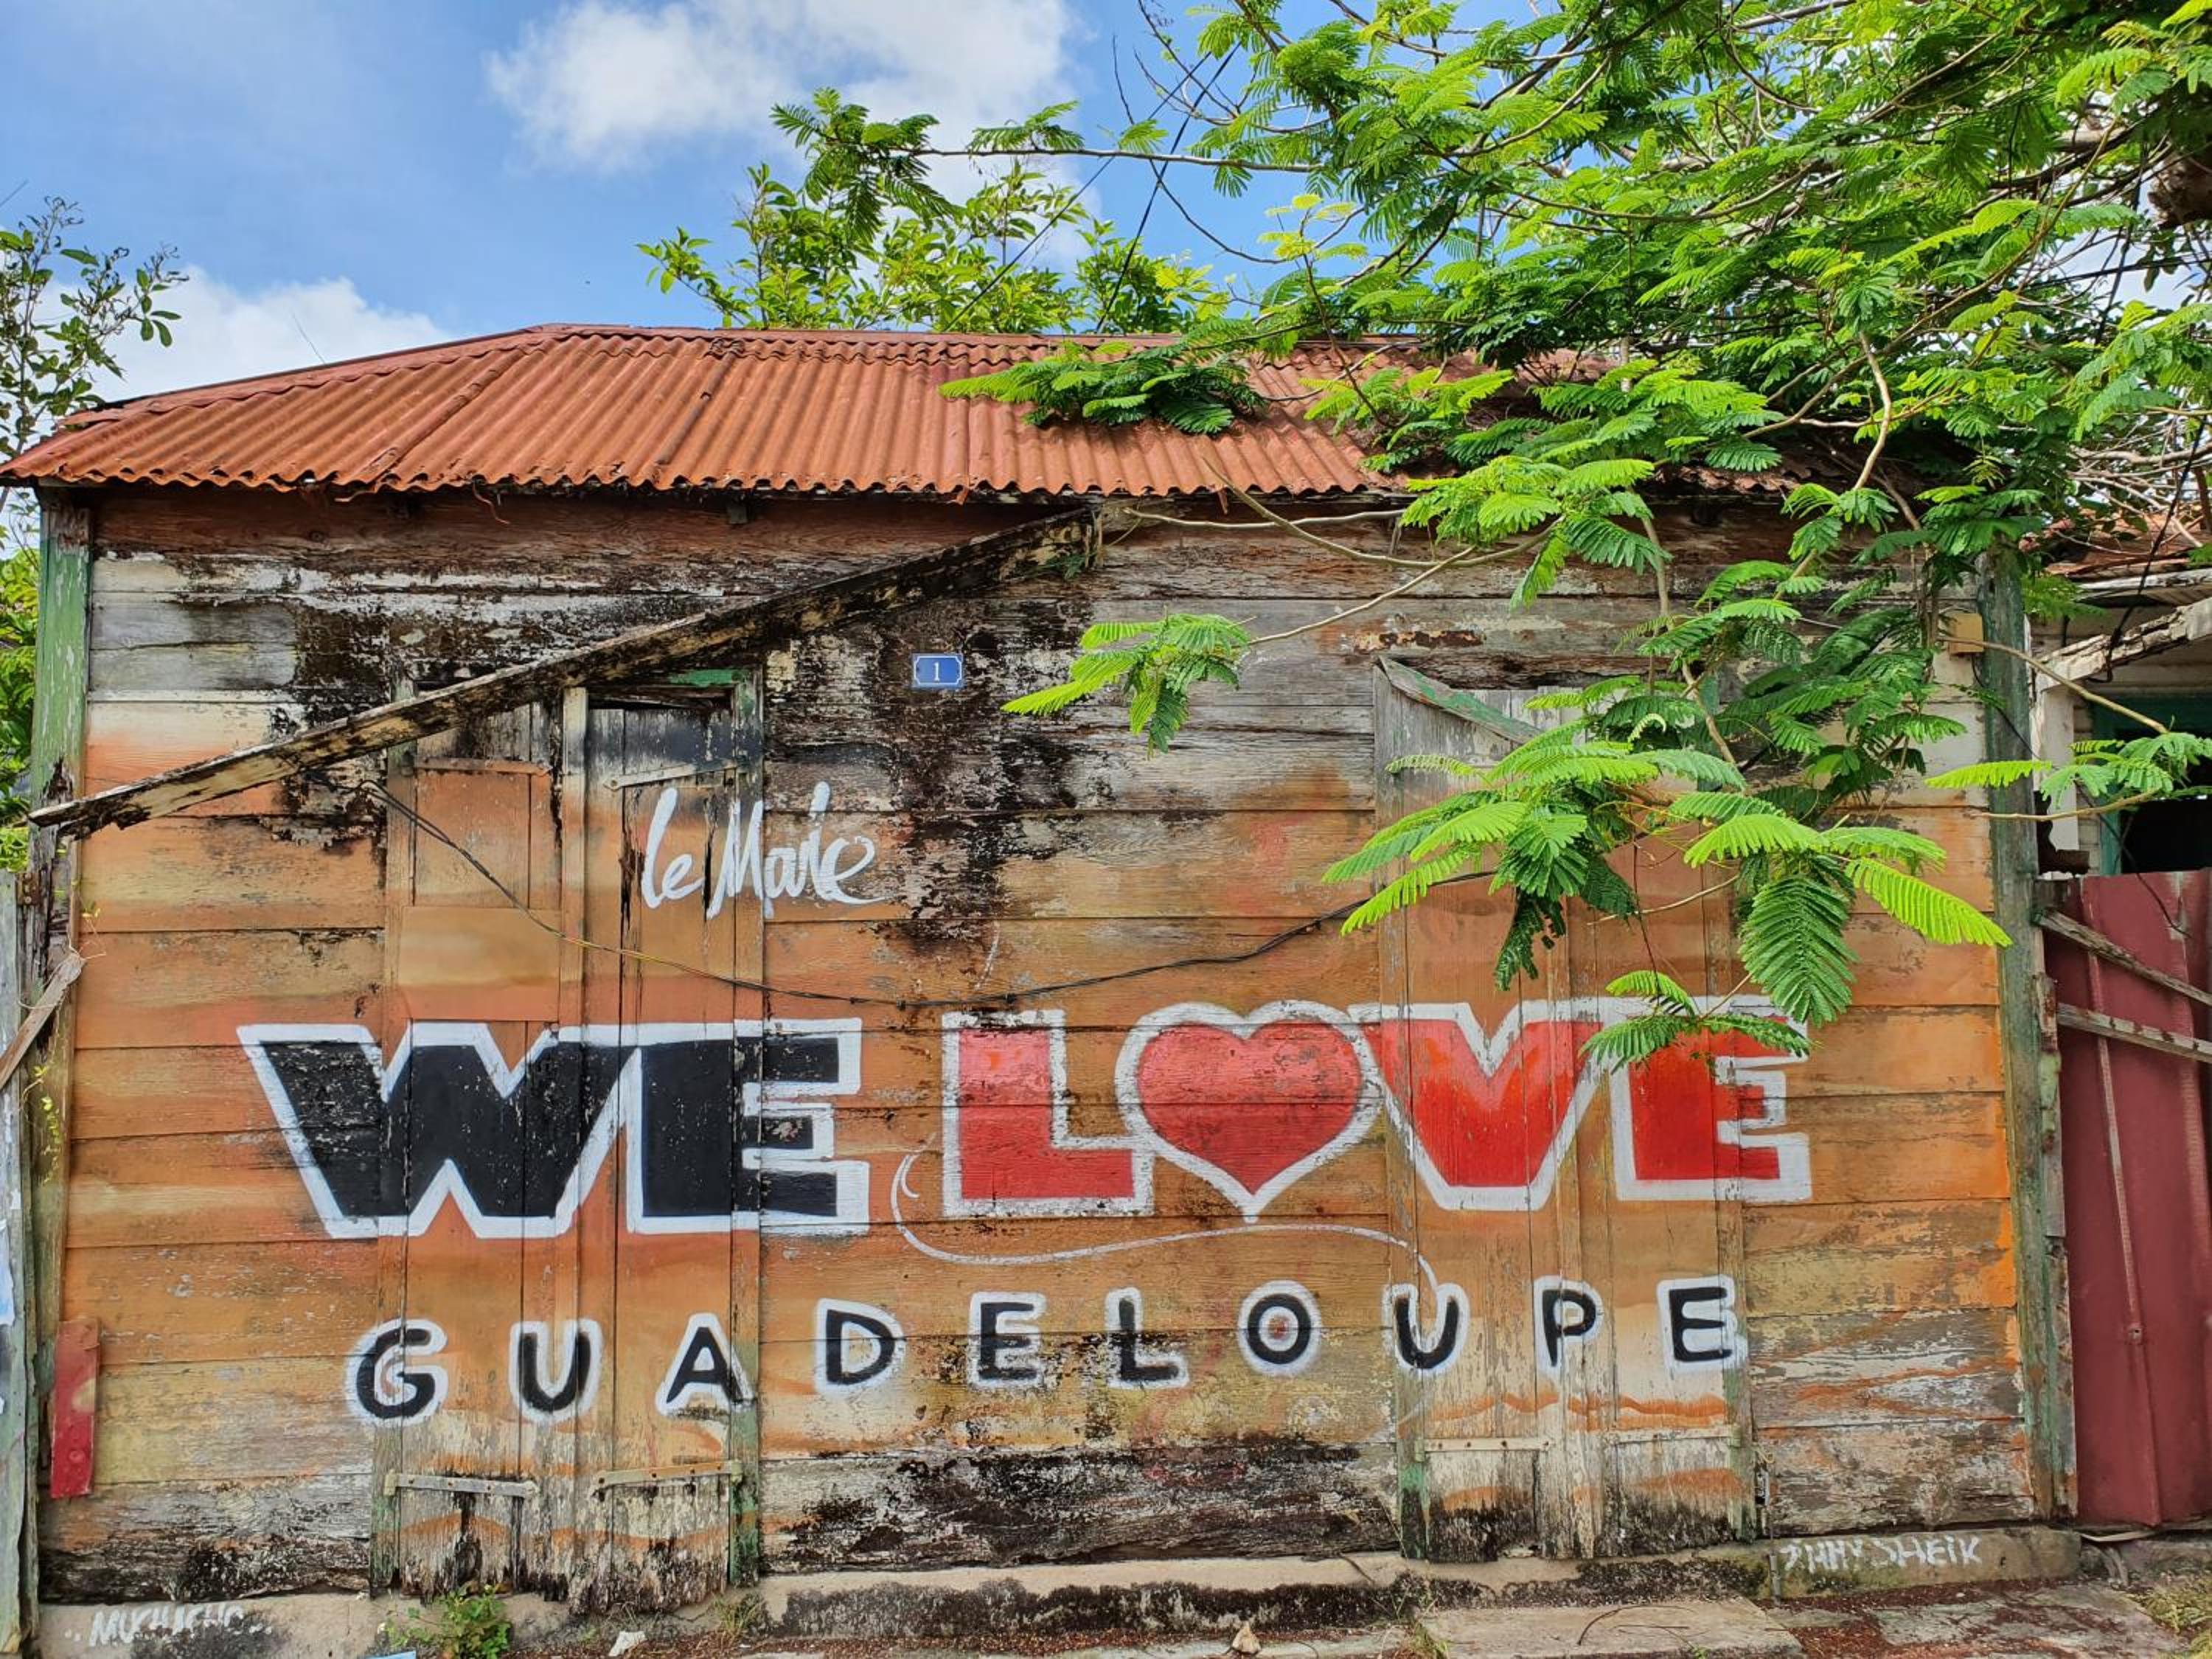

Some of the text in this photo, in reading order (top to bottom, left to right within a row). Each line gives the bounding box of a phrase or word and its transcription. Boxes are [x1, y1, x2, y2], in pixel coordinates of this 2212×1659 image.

[932, 661, 942, 682] 1
[236, 1016, 873, 1240] WE
[344, 1274, 1749, 1428] GUADELOUPE
